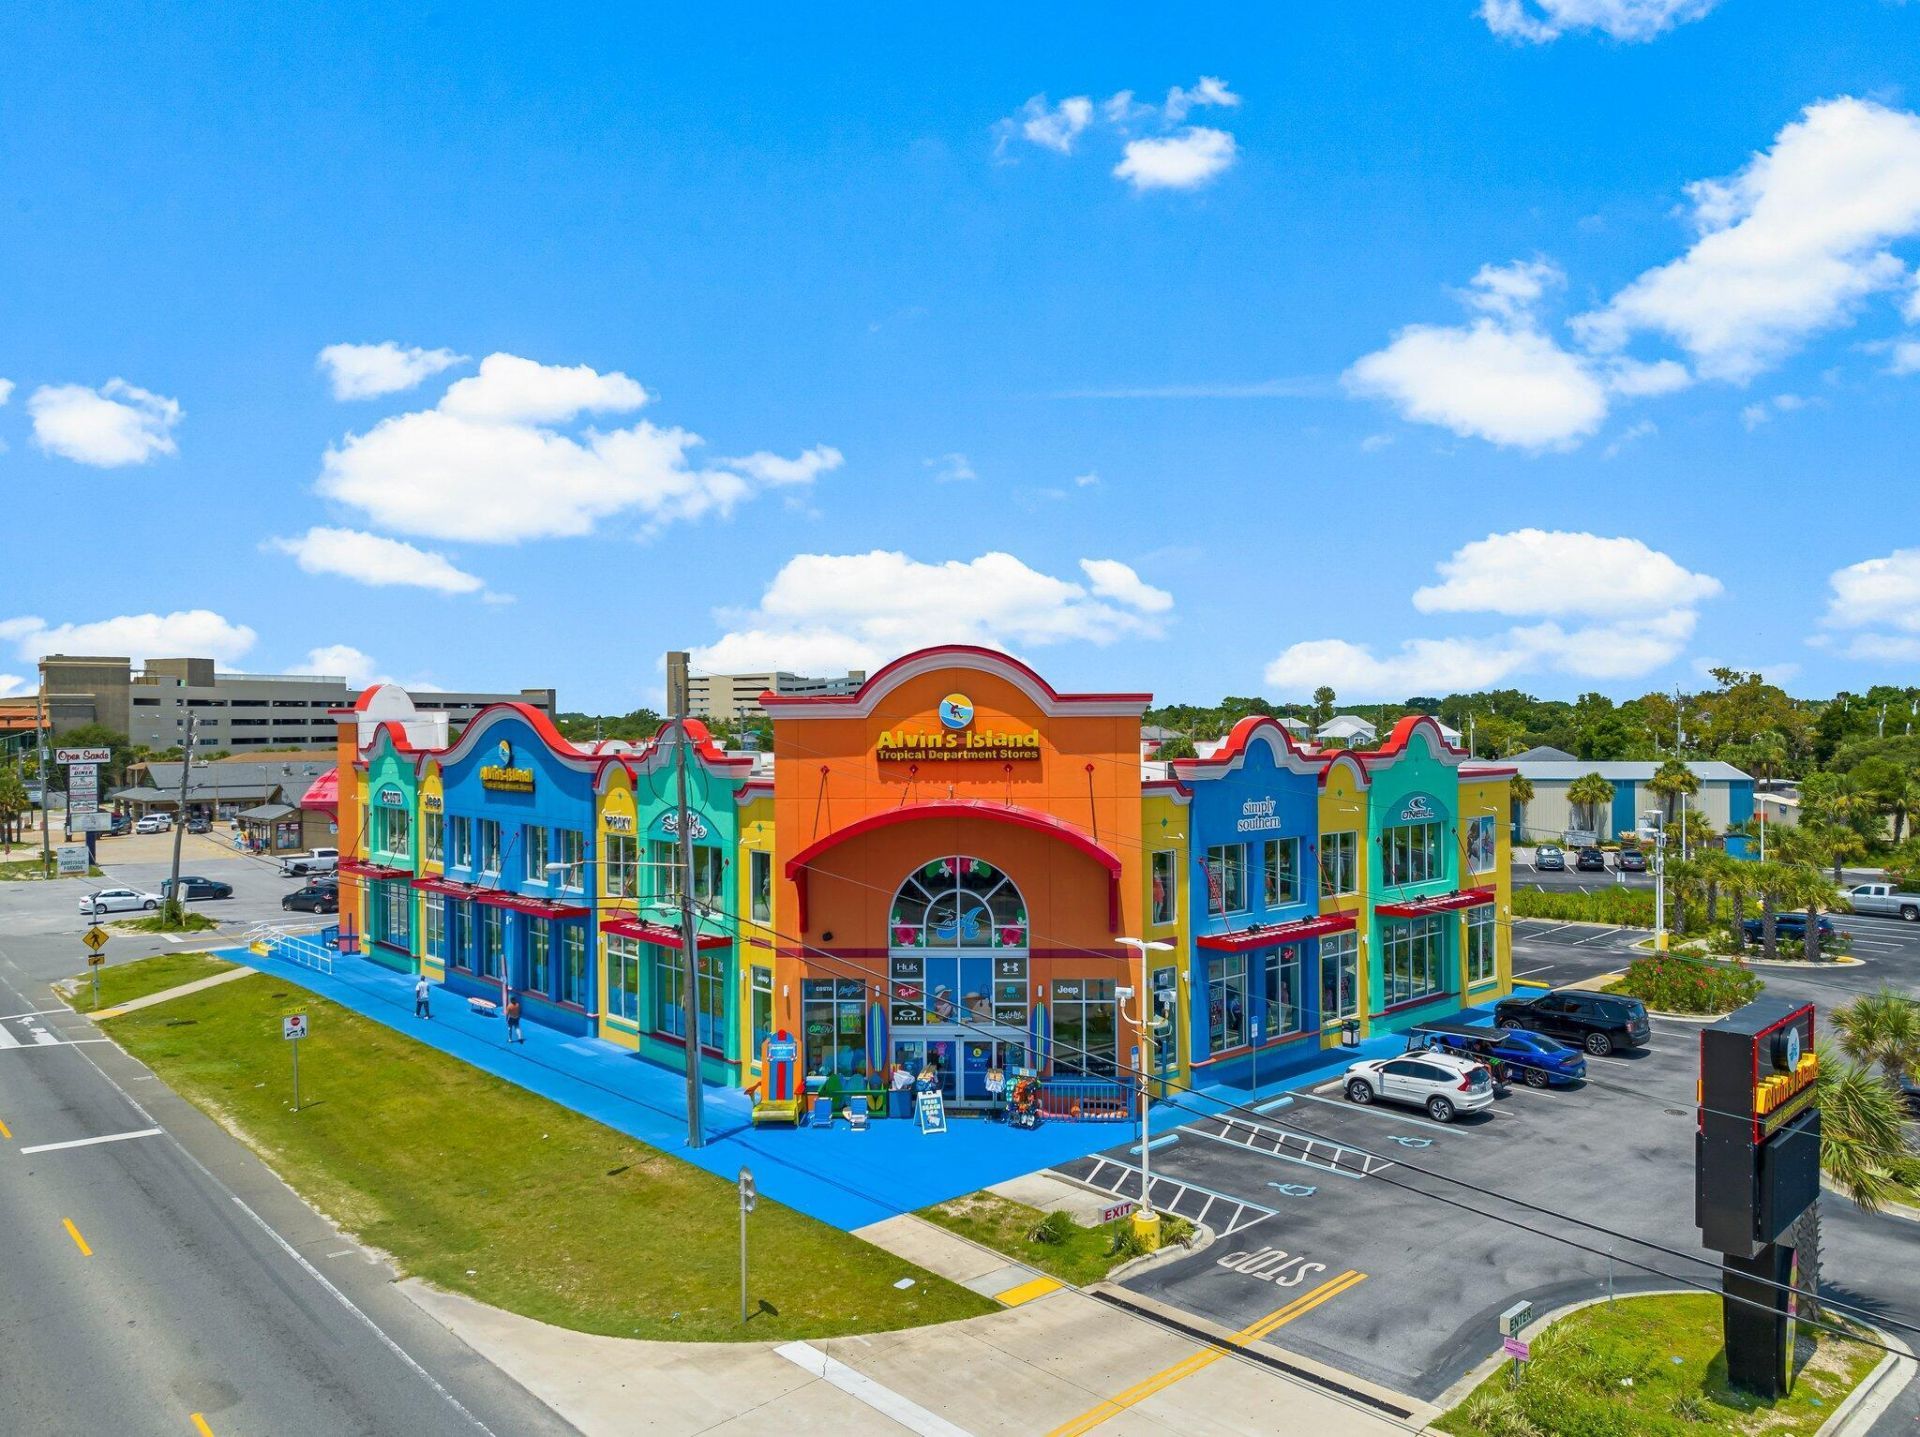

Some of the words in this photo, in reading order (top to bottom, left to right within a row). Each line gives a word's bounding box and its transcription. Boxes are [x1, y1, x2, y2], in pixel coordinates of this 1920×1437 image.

[876, 729, 958, 749] Alvin's
[966, 729, 1039, 748] Island
[57, 750, 80, 762] Open
[82, 750, 109, 760] Sands
[878, 750, 926, 760] Tropical
[928, 750, 997, 760] Department
[1000, 750, 1038, 759] Stores
[425, 794, 441, 808] Jeep
[1242, 796, 1276, 816] simply
[613, 816, 632, 830] ROXY
[1237, 816, 1281, 833] southern
[896, 962, 918, 971] Huk
[757, 974, 770, 983] Jeep
[1057, 985, 1079, 995] Jeep
[1104, 1203, 1132, 1221] EXIT
[1217, 1246, 1327, 1287] STOP
[1509, 1307, 1532, 1332] ENTER
